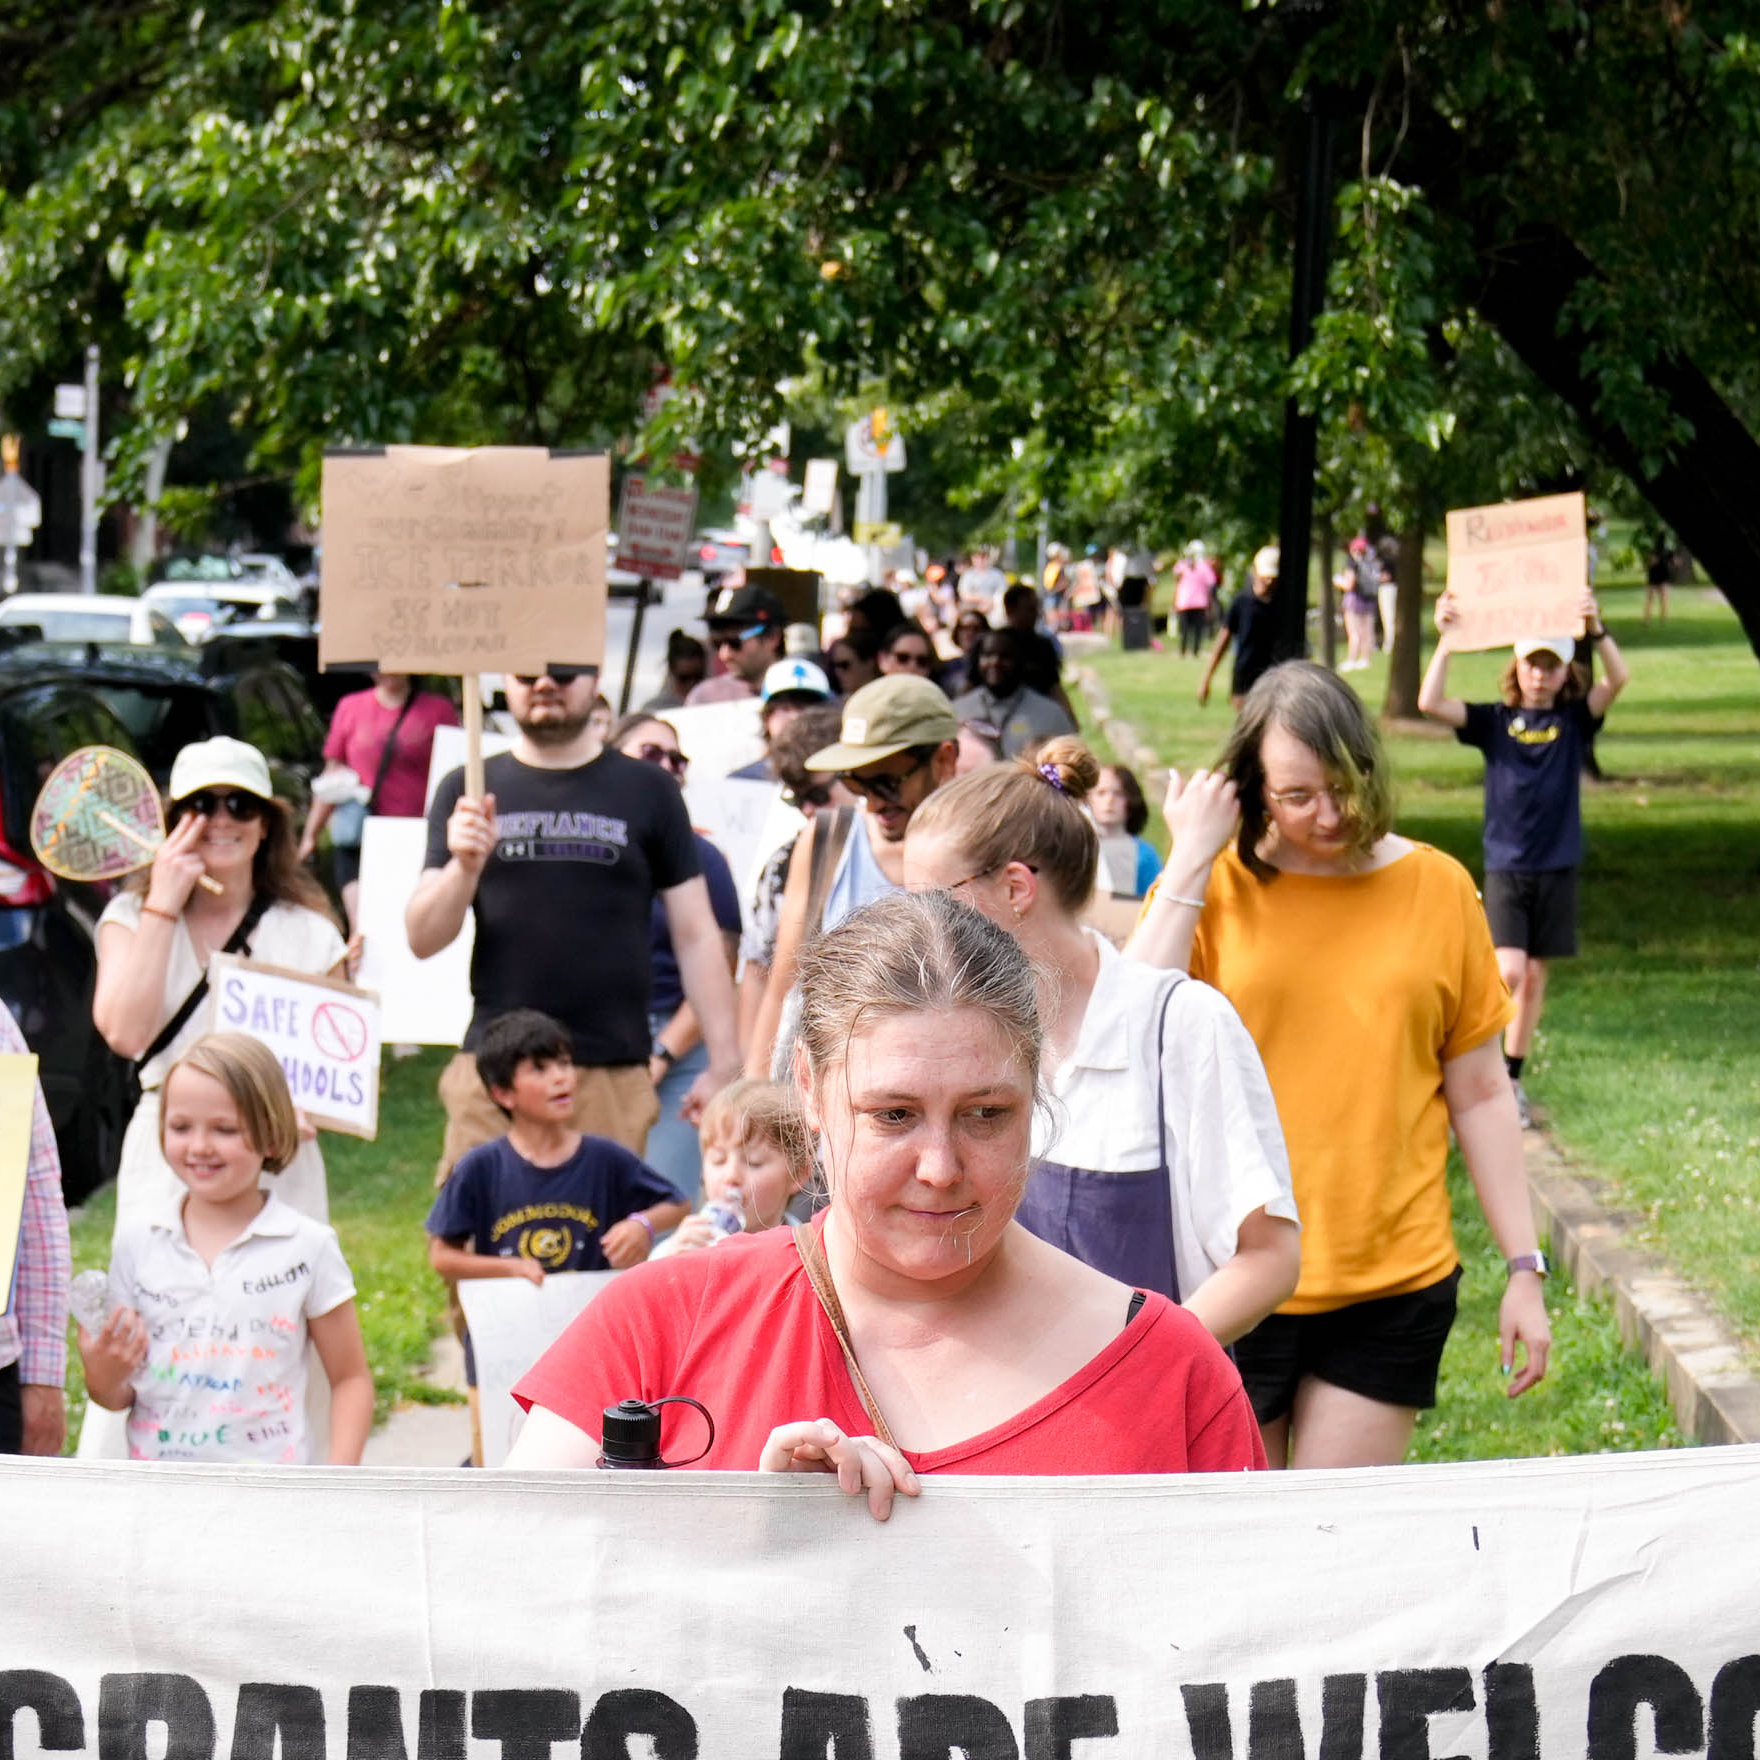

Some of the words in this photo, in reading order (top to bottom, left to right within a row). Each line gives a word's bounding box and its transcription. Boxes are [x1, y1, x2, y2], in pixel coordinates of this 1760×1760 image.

[351, 543, 432, 591] ICE
[222, 978, 300, 1036] SAFE
[282, 1055, 364, 1105] HOOLS
